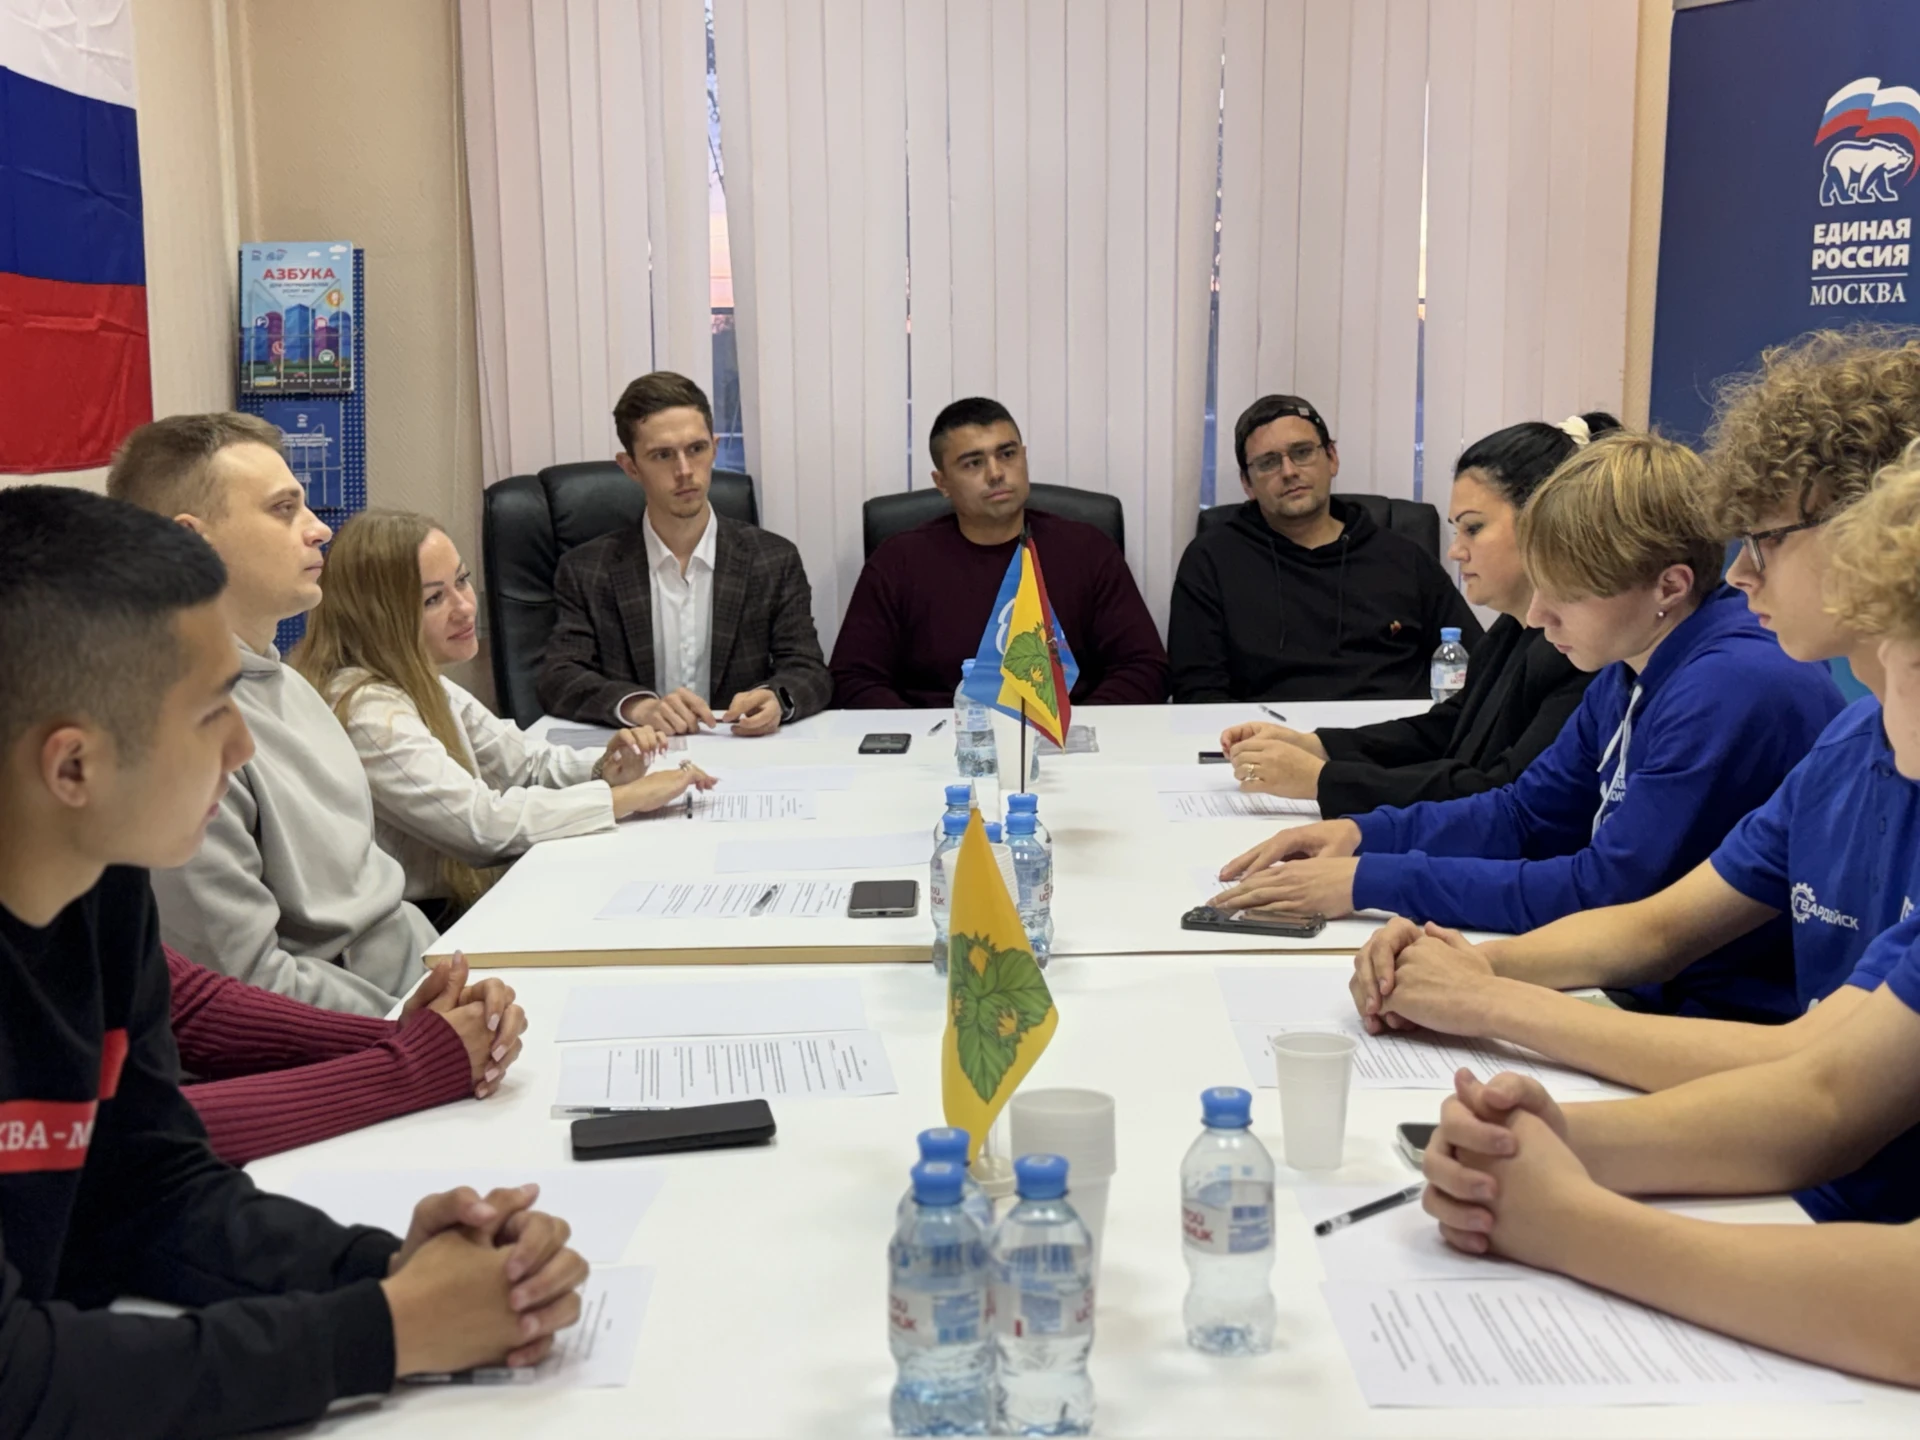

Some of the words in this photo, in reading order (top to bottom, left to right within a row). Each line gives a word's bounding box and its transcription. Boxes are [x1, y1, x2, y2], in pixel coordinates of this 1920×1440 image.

[1813, 218, 1911, 245] ЕДИНАЯ
[1811, 244, 1910, 271] РОССИЯ
[262, 267, 336, 281] АЗБУКА
[1810, 282, 1907, 306] МОСКВА
[1795, 895, 1859, 931] ГВАРДЕЙСК
